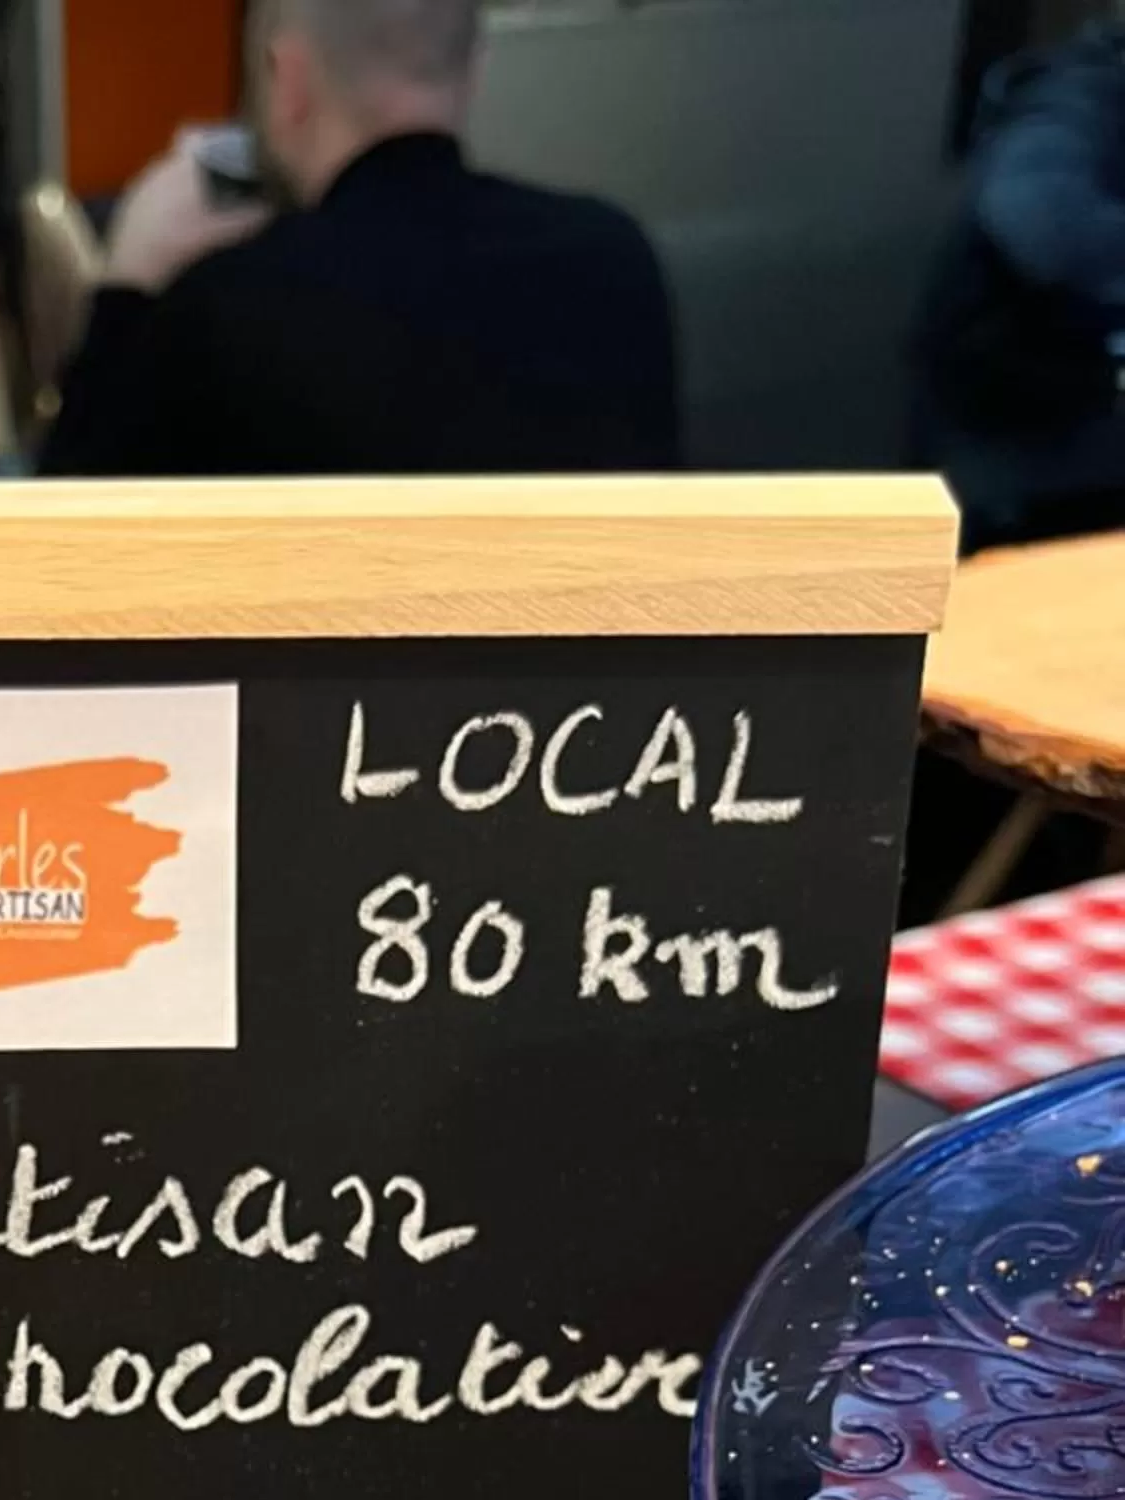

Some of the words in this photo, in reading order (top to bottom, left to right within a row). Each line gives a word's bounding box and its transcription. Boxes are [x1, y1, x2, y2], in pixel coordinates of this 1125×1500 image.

[341, 702, 803, 823] LOCAL
[357, 875, 525, 1002] 80
[579, 887, 839, 1010] km
